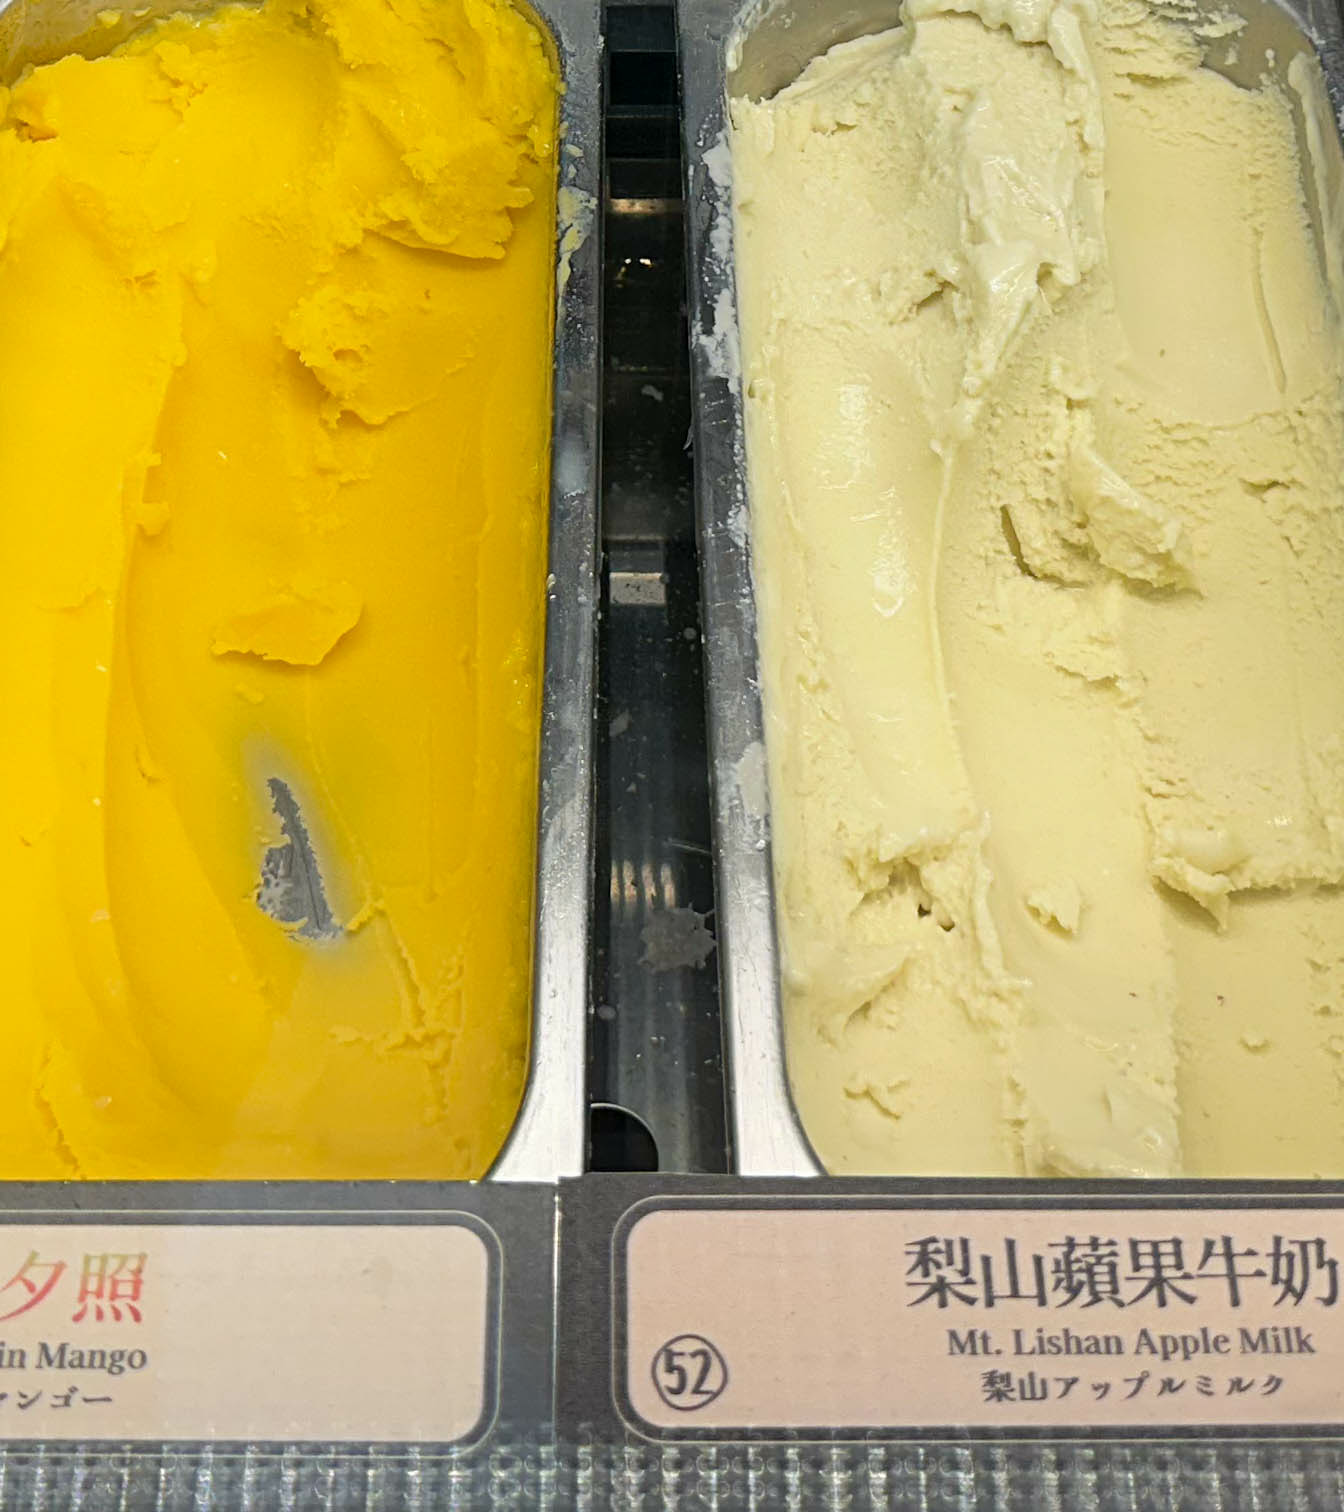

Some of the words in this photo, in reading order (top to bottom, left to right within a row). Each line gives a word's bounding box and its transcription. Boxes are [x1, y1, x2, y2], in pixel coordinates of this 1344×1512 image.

[904, 1235, 1339, 1309] 梨山蘋果牛奶
[35, 1342, 148, 1375] Mango
[947, 1328, 1003, 1357] Mt.
[1013, 1326, 1124, 1356] Lishan
[1134, 1327, 1231, 1362] Apple
[1239, 1326, 1316, 1356] Milk
[981, 1369, 1284, 1403] 梨山アップルミルク
